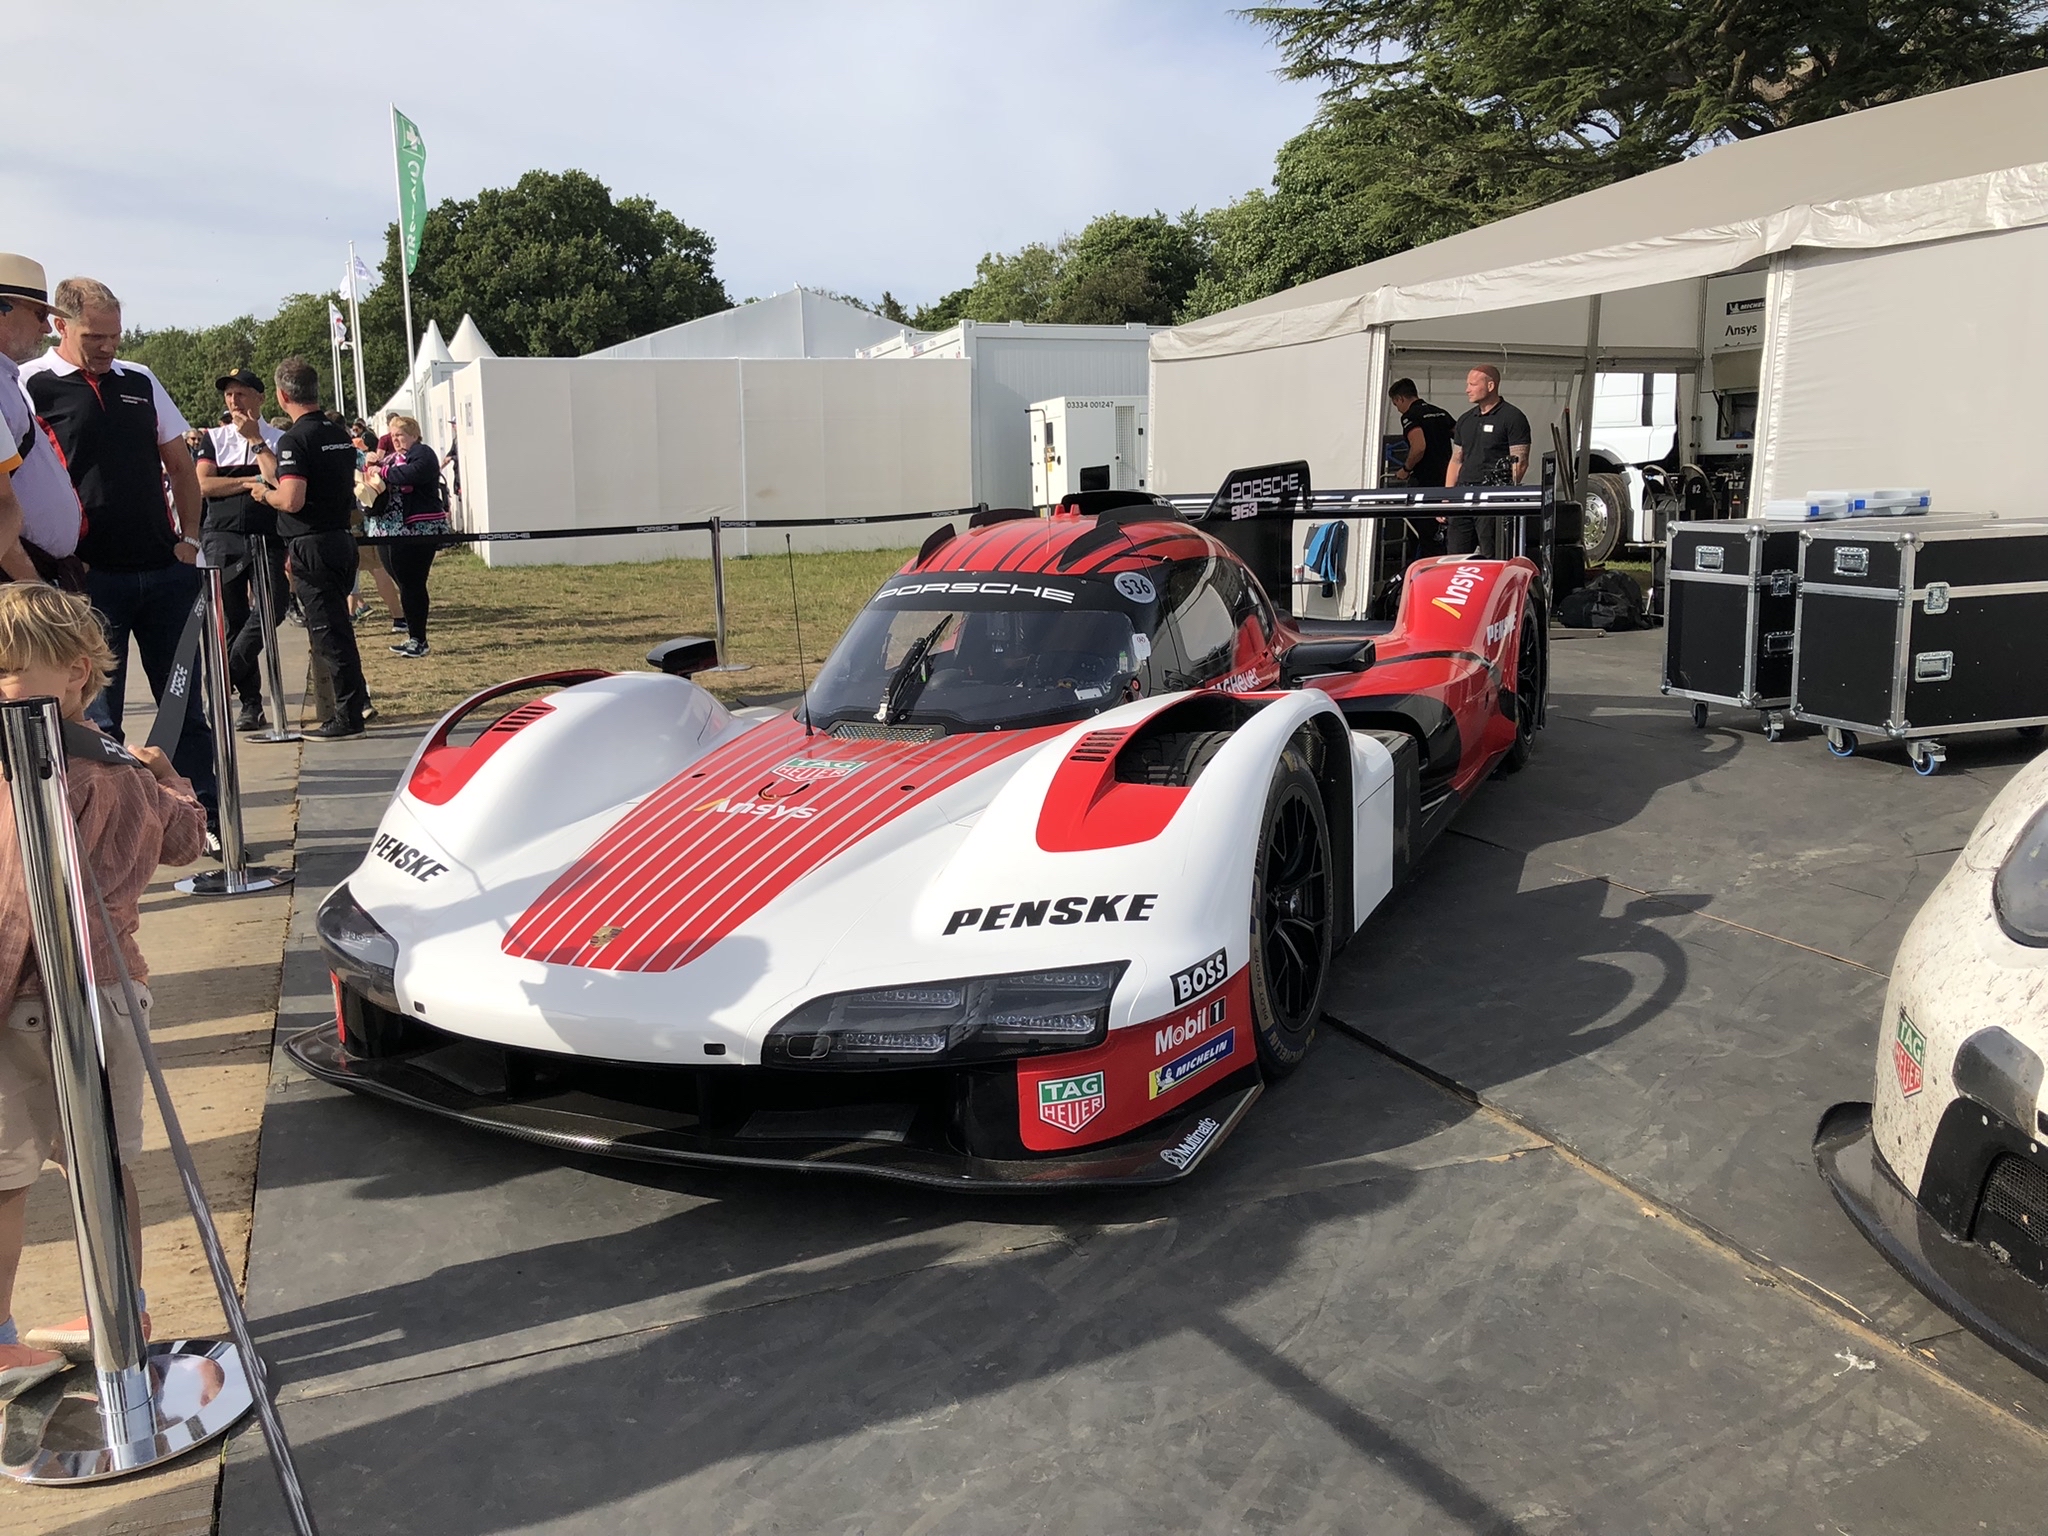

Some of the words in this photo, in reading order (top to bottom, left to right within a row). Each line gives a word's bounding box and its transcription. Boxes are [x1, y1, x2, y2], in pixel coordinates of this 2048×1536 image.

[1724, 324, 1758, 337] Ansys
[1066, 401, 1089, 409] 03334
[1089, 401, 1114, 409] 001247
[321, 443, 354, 452] PORSCH
[1230, 472, 1299, 502] PORSCHE
[1231, 501, 1258, 521] 963
[478, 532, 531, 541] PORSCHE
[636, 524, 680, 533] PORSCHE
[874, 582, 1076, 604] PORSCHE
[1119, 578, 1152, 597] 536
[1431, 565, 1485, 620] Ansys
[169, 663, 189, 698] PORSCHE
[777, 767, 848, 780] HEUER
[796, 760, 859, 768] TAG
[693, 797, 819, 820] Ansys
[370, 832, 451, 883] PENSKE
[941, 893, 1160, 936] PENSKE
[1176, 954, 1226, 1001] BOSS
[1253, 946, 1264, 986] SPORT
[1258, 990, 1270, 1020] PILOT
[1155, 1006, 1207, 1056] Mobil
[1213, 1001, 1221, 1022] 1
[1900, 1020, 1922, 1063] TAG
[1174, 1039, 1229, 1078] MICHELIN
[1044, 1077, 1098, 1100] TAG
[1044, 1097, 1101, 1128] HEUER
[1173, 1117, 1217, 1162] Multimatic
